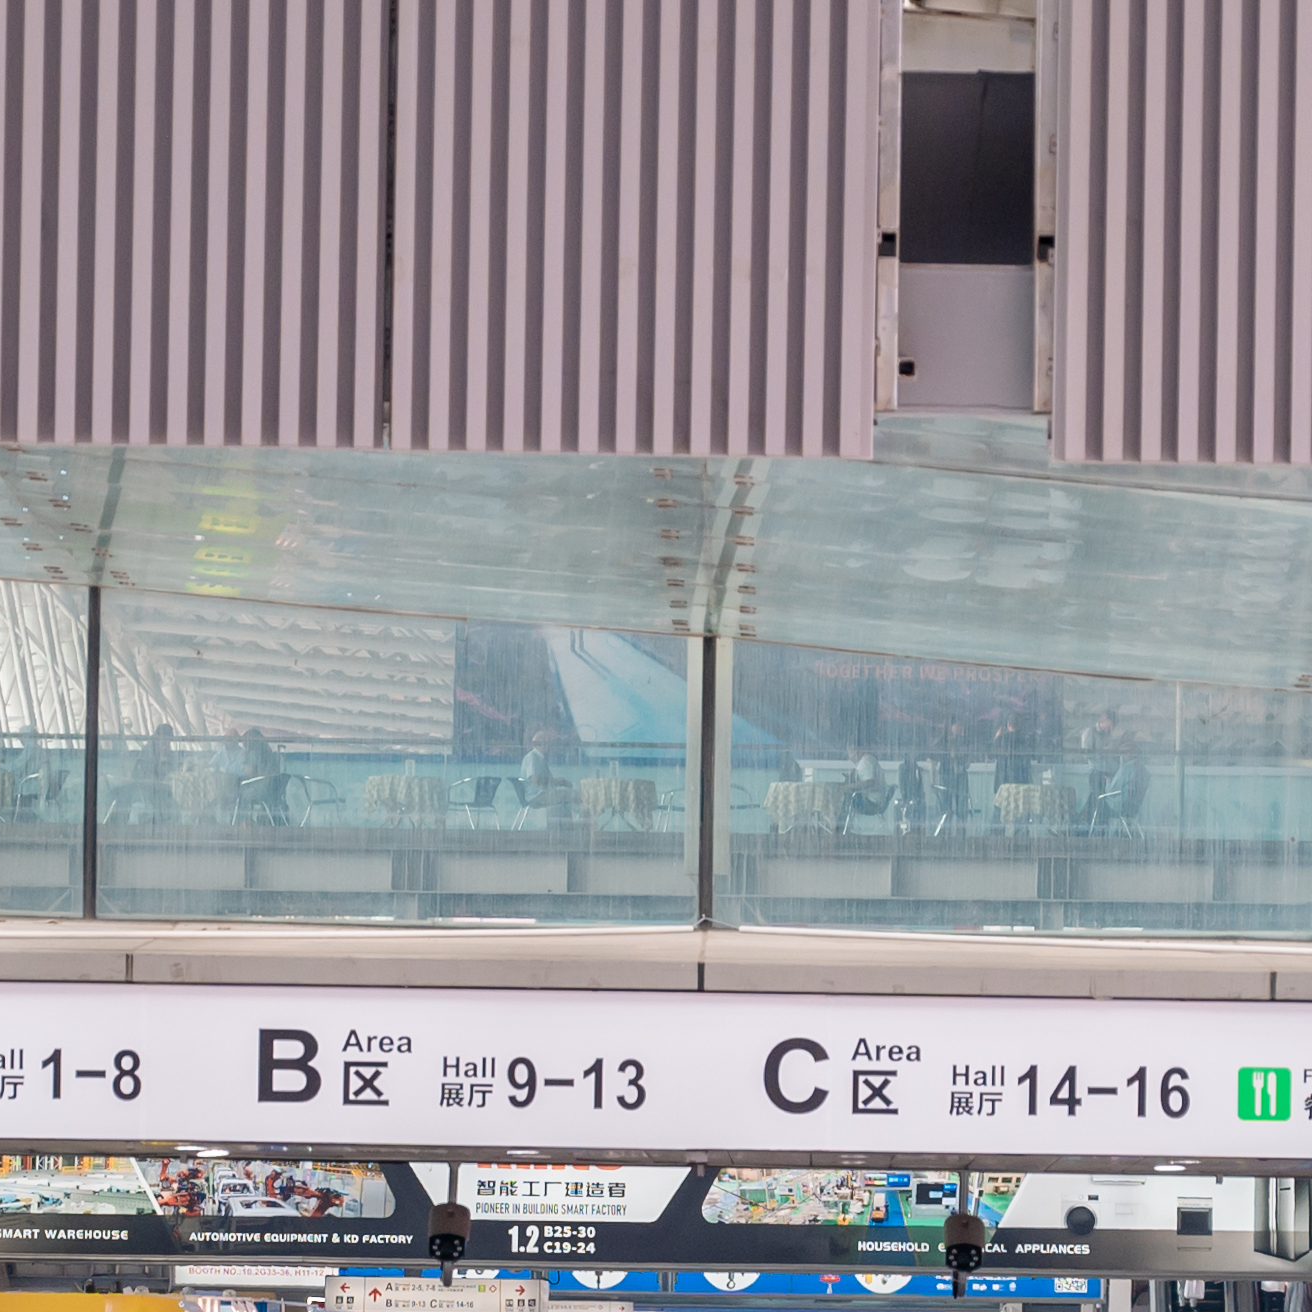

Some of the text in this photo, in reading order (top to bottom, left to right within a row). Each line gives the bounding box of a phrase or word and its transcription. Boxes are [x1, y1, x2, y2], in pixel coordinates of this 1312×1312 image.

[342, 1030, 411, 1053] Area
[852, 1038, 920, 1061] Area
[258, 1029, 321, 1102] B
[443, 1057, 495, 1078] Hall
[764, 1038, 829, 1114] C
[953, 1065, 1004, 1086] Hall
[343, 1061, 389, 1106] 区
[852, 1070, 898, 1115] 区
[440, 1083, 493, 1108] 展厅
[950, 1092, 1002, 1116] 展厅
[476, 1180, 626, 1198] 智能工厂建造者
[476, 1202, 627, 1217] PIONEER IN BUILDING SMART FACTORY
[45, 1230, 128, 1240] WAREHOUSE
[189, 1232, 413, 1244] AUTOMOTIVE EQUIPMENT & KD FACTORY
[508, 1225, 539, 1253] 1.2
[544, 1226, 595, 1238] B25-30
[543, 1242, 596, 1254] C19-24
[858, 1241, 929, 1252] HOUSEHOLD
[1015, 1244, 1090, 1254] APPLIANCES
[189, 1266, 220, 1275] BOOTH
